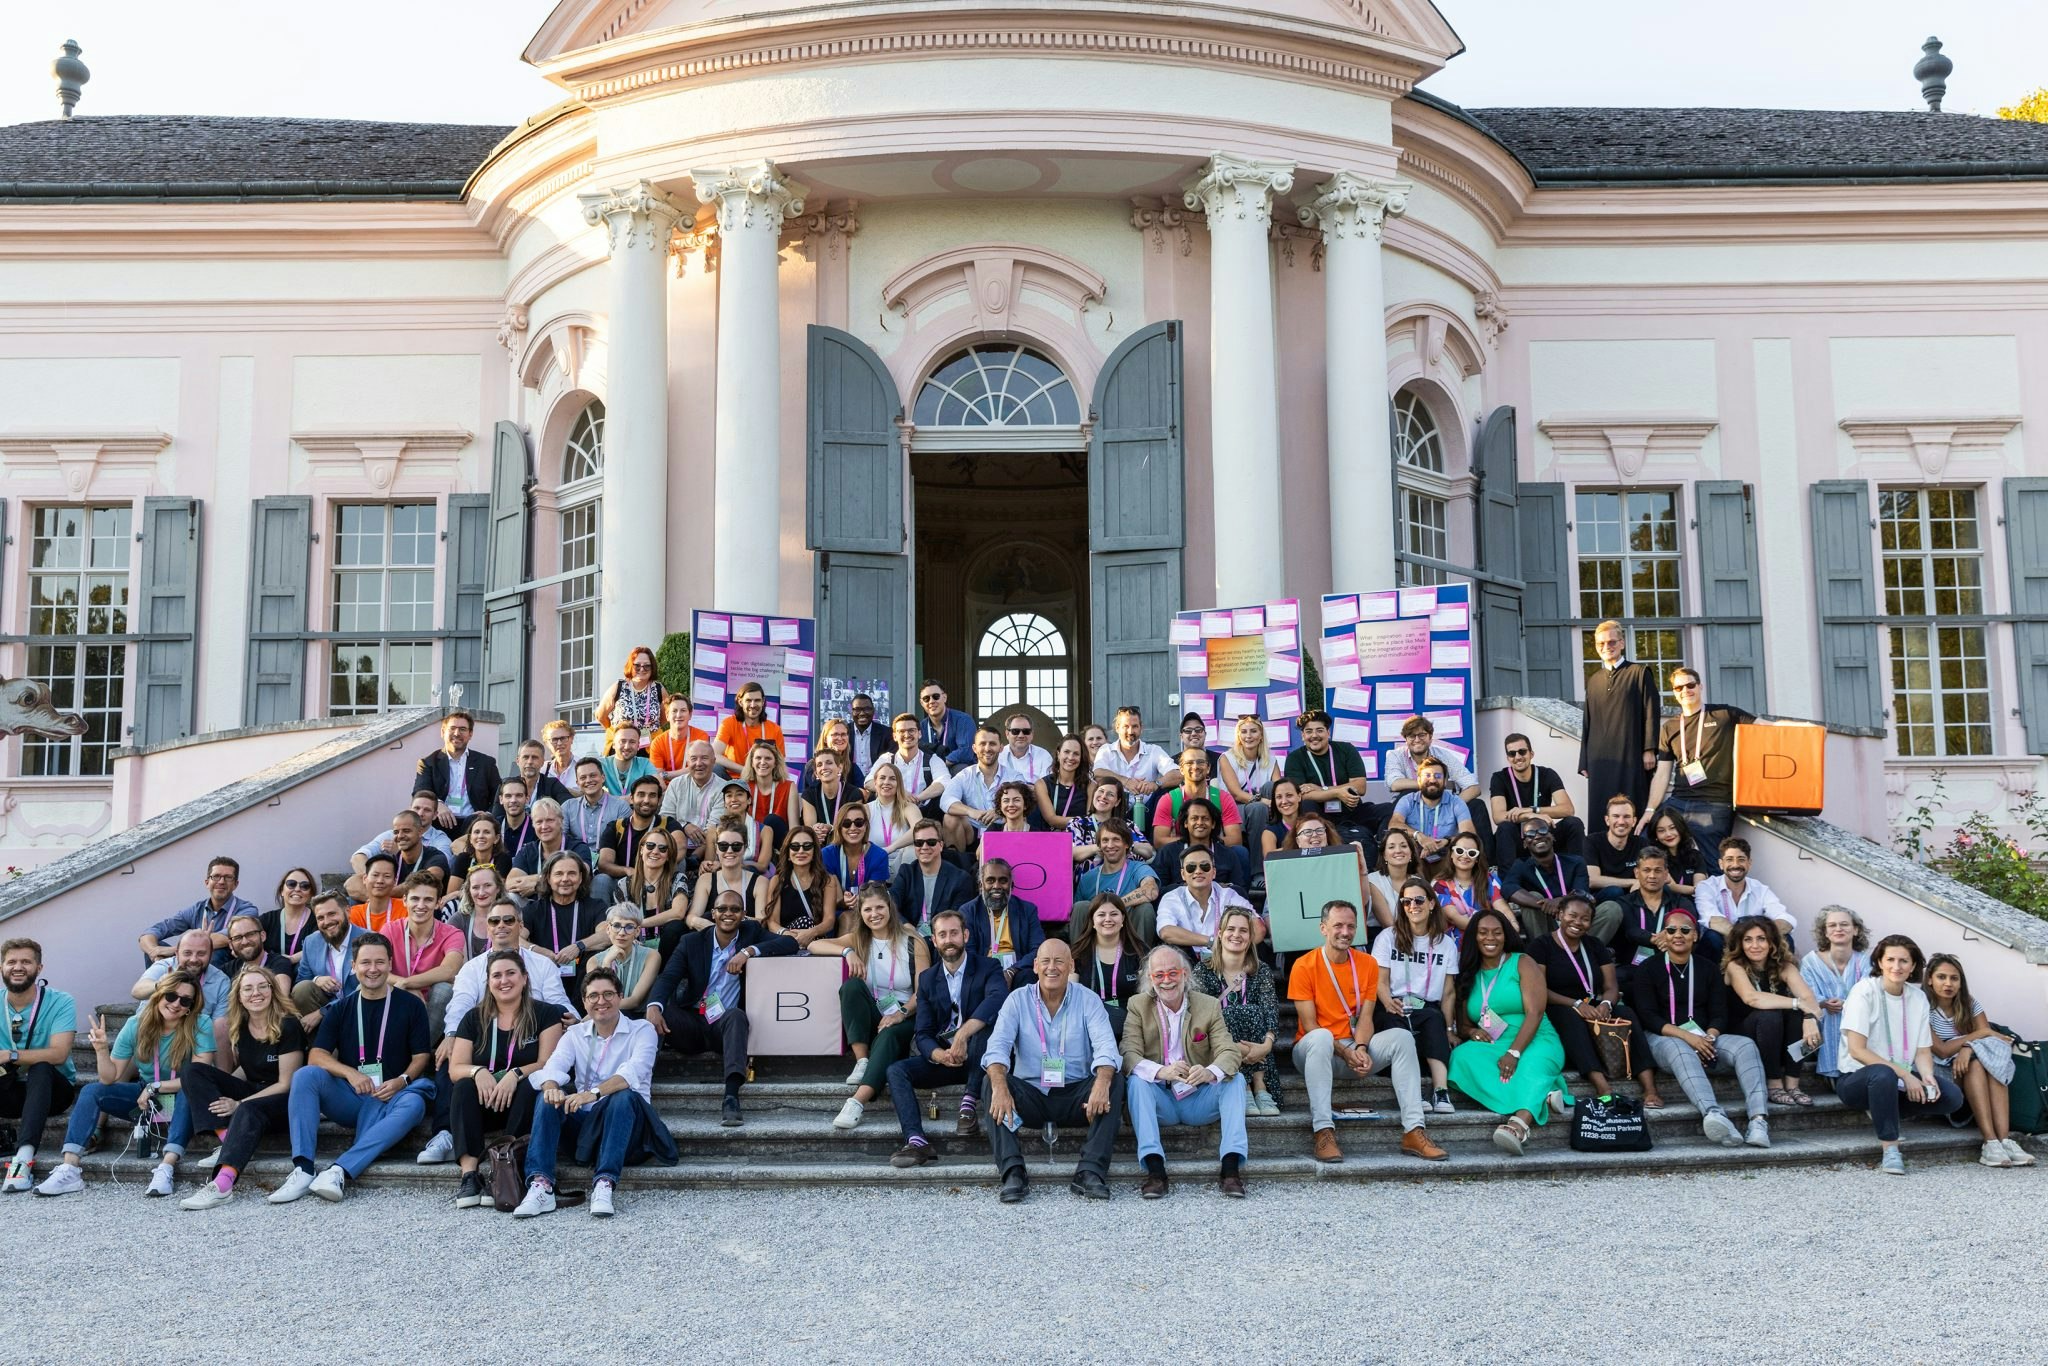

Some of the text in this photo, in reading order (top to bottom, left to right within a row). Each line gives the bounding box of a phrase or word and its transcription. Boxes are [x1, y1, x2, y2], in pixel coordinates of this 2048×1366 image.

[1763, 754, 1797, 779] D
[1011, 862, 1047, 891] O
[1299, 891, 1322, 920] L
[1390, 949, 1443, 966] BEIEVE
[776, 991, 811, 1022] B
[1580, 1131, 1616, 1140] 11238-6052
